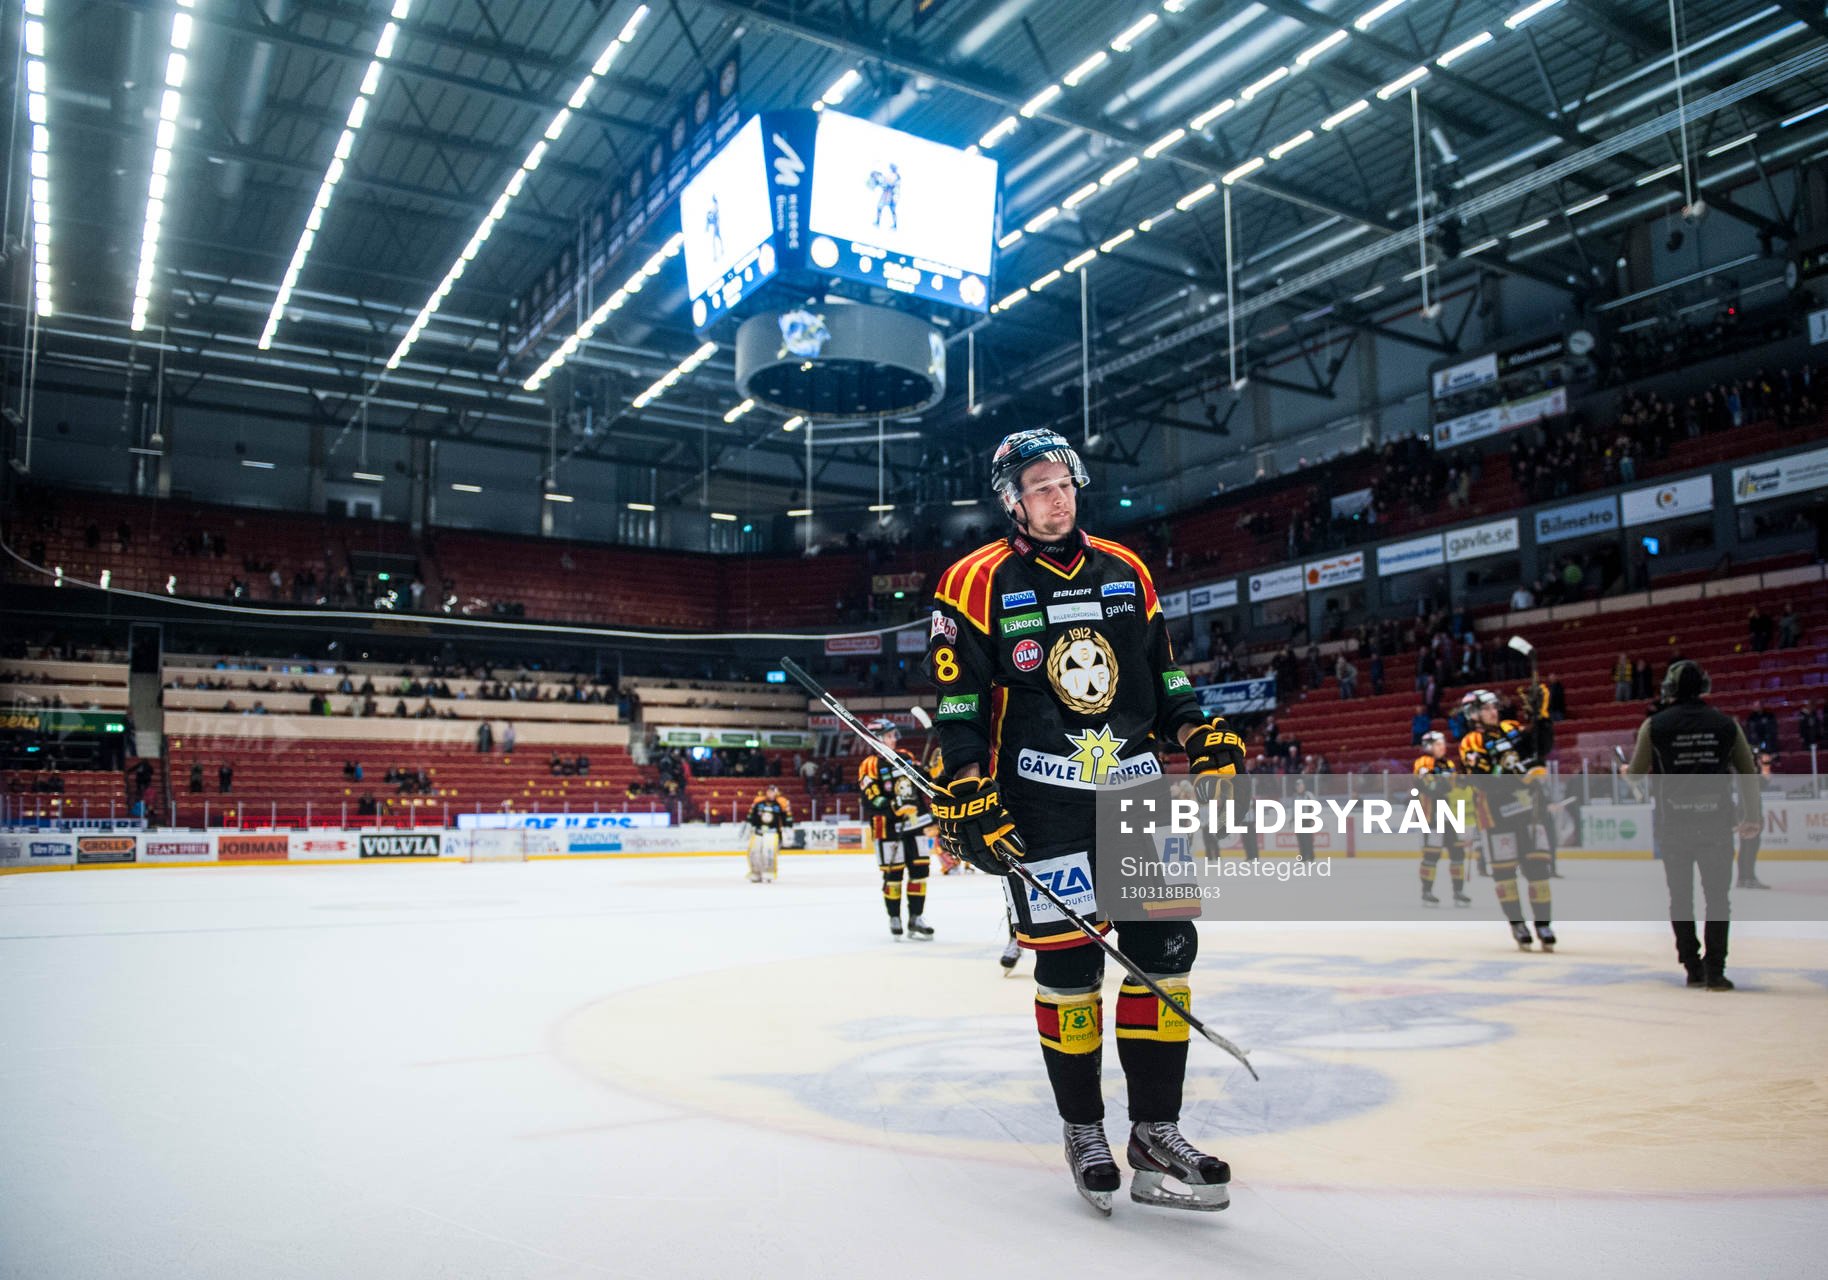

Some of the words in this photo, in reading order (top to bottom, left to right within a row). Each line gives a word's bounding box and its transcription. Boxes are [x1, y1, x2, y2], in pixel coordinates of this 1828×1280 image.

[1540, 508, 1613, 536] Bilmetro
[1003, 591, 1035, 602] SANDVIK
[1003, 617, 1043, 633] Läkerol
[1068, 627, 1092, 640] 1912
[1016, 648, 1039, 663] OLW
[936, 647, 959, 682] 8
[1019, 755, 1077, 782] GÄVLE
[1110, 759, 1159, 786] ENERGI
[811, 830, 836, 840] NFS
[83, 841, 131, 850] GROLLS
[219, 841, 288, 855] JOBMAN
[363, 836, 438, 855] VOLVIA
[1066, 1031, 1095, 1042] preem
